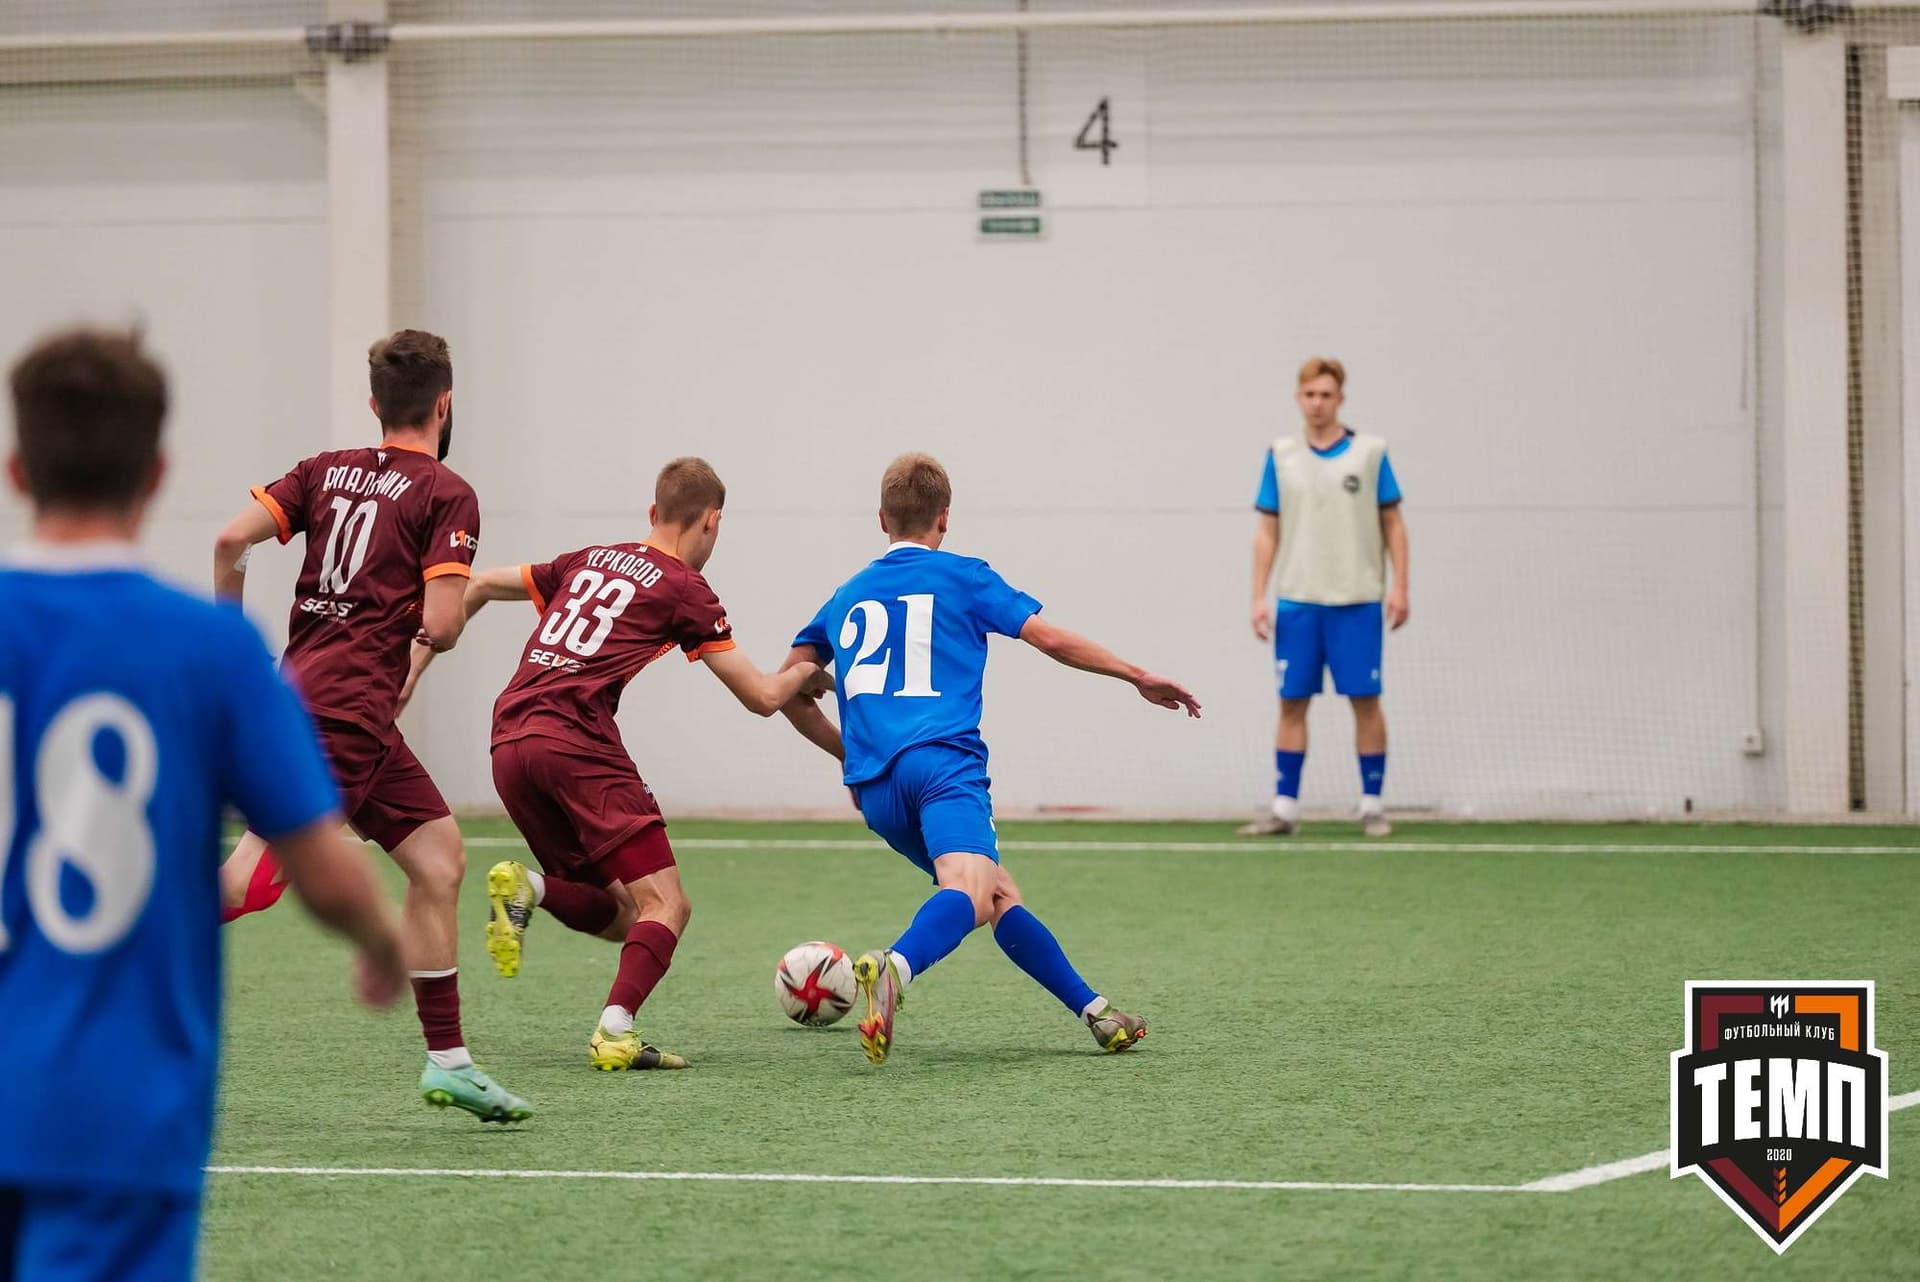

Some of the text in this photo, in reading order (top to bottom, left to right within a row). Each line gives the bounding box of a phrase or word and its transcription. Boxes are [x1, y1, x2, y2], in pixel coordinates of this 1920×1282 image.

[1074, 97, 1117, 165] 4
[319, 496, 378, 594] 10
[586, 549, 664, 589] ЧЕРКАСОВ
[539, 569, 636, 657] 33
[839, 593, 942, 701] 21
